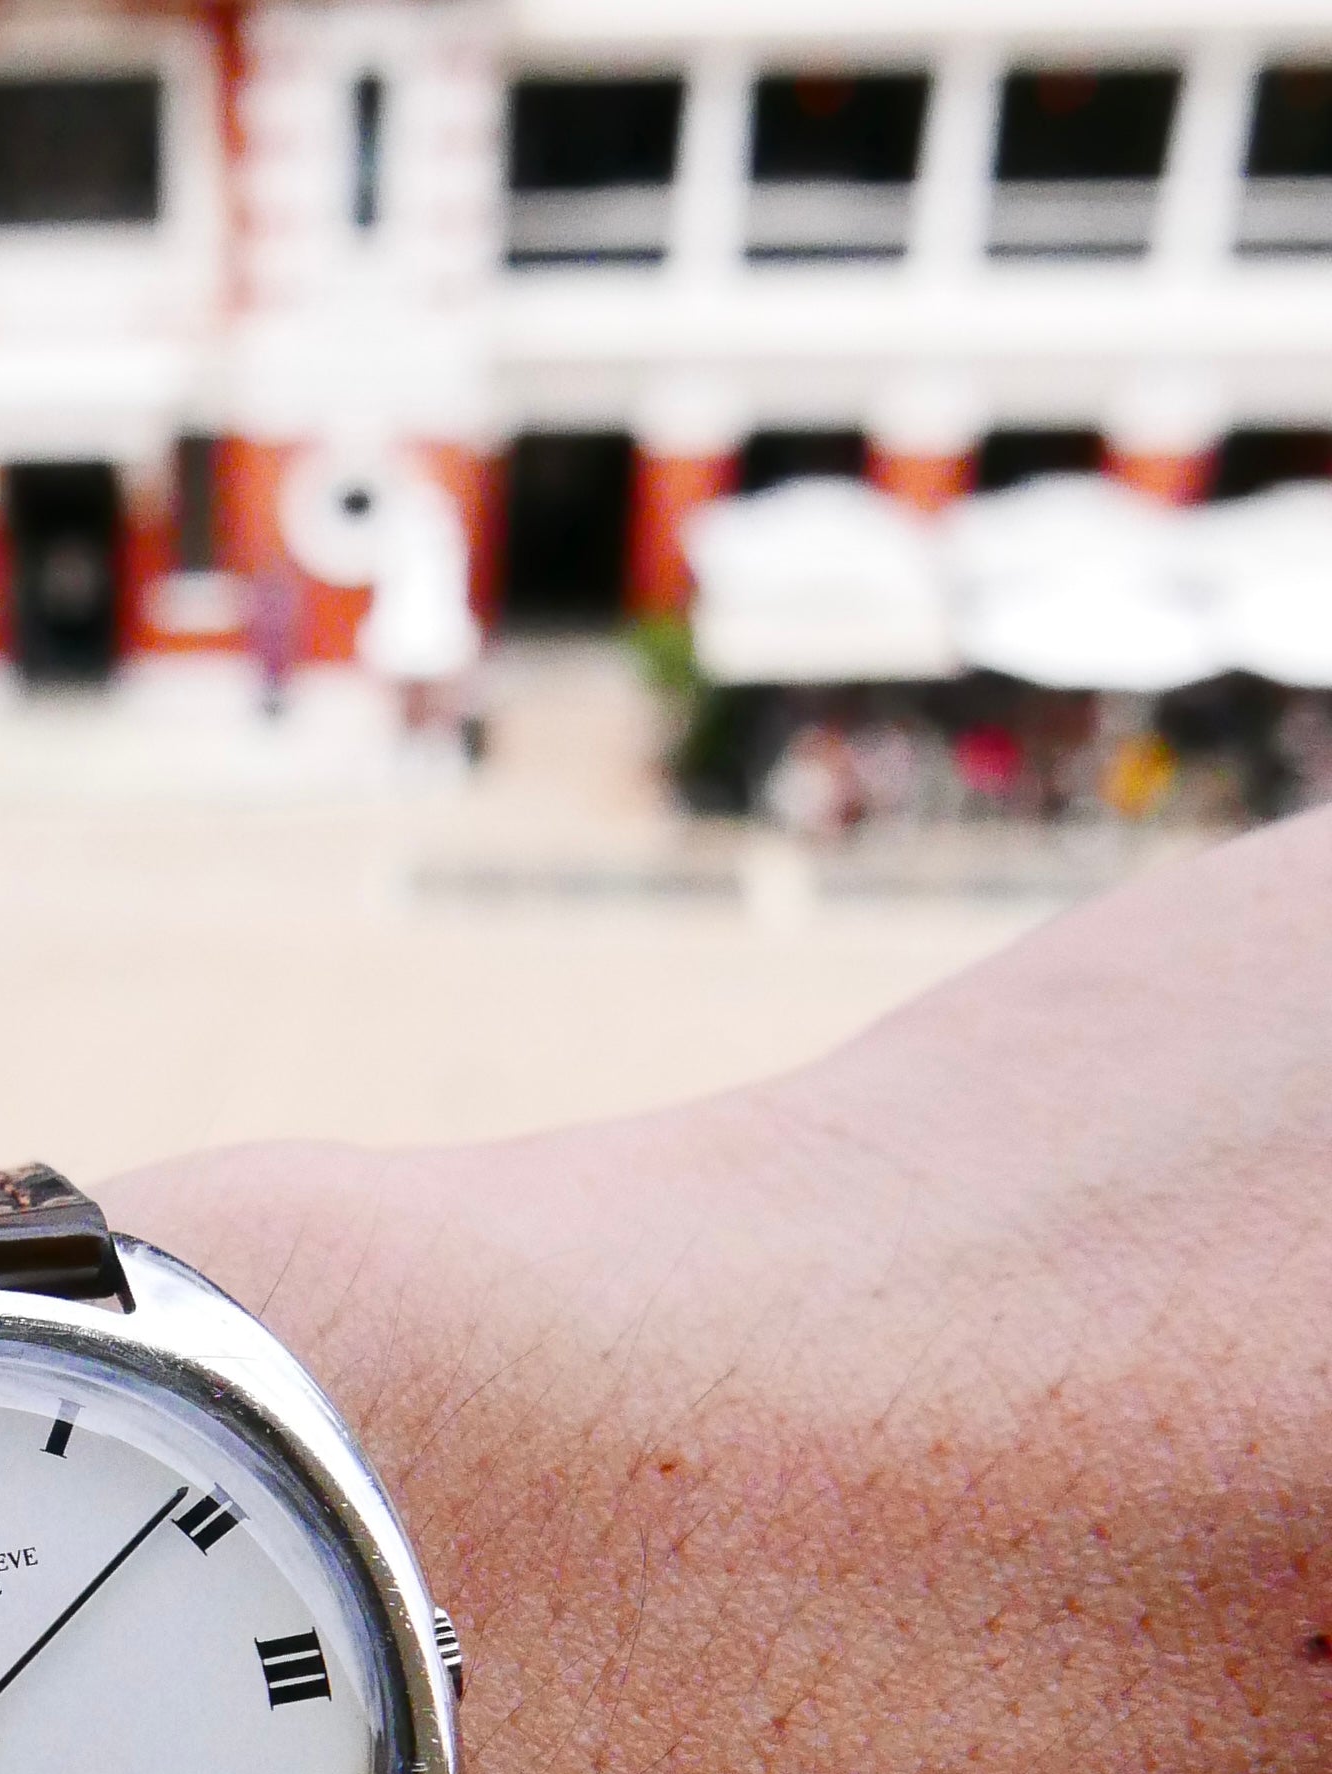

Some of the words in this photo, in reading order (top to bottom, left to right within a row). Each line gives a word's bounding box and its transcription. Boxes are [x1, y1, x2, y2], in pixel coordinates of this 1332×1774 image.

[40, 1397, 86, 1458] I
[172, 1482, 251, 1555] II
[254, 1627, 332, 1711] III
